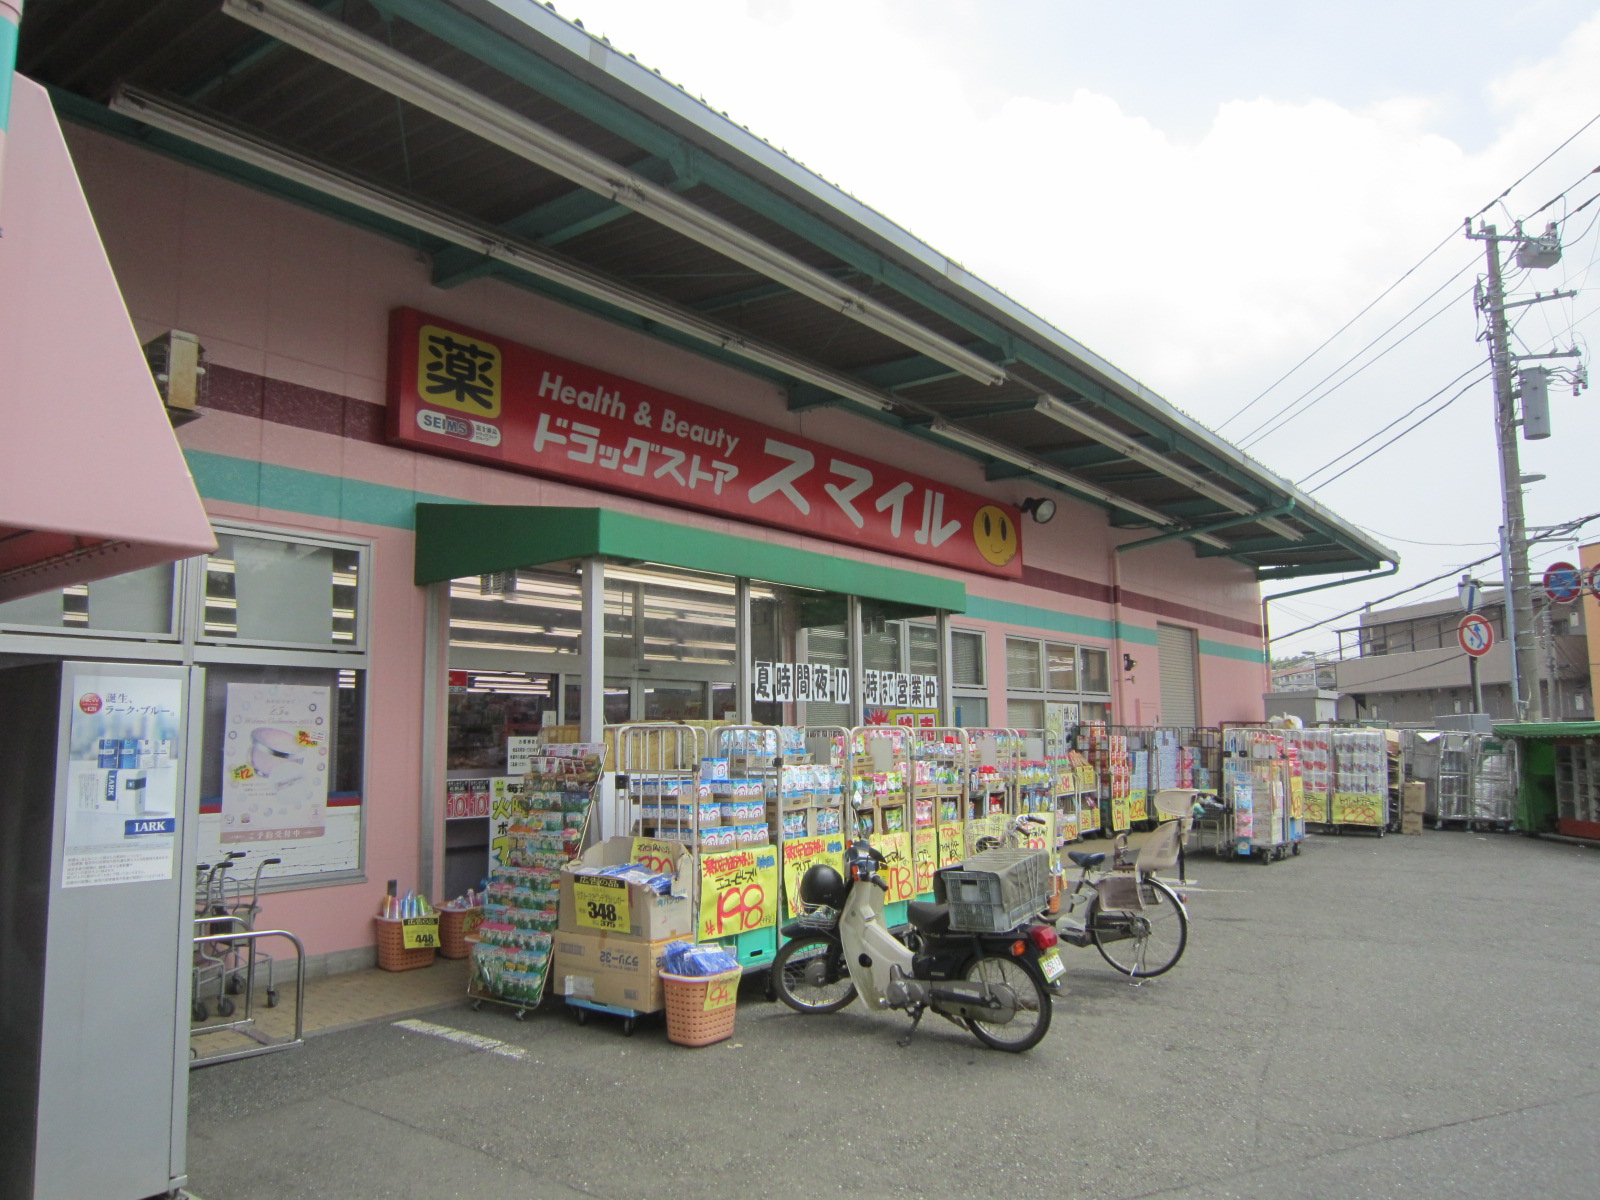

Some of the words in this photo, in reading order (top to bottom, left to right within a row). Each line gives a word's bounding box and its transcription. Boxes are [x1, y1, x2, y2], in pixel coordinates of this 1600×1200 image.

[425, 334, 495, 410] 薬
[423, 414, 468, 435] SEIMS
[538, 371, 626, 421] Health
[633, 401, 653, 428] &
[660, 409, 740, 457] Beauty
[533, 412, 739, 495] ドラッグストア
[748, 438, 962, 548] スマイル
[107, 774, 115, 797] LARK
[134, 820, 166, 833] LARK
[579, 875, 620, 888] 広告の品
[587, 901, 617, 922] 348
[415, 934, 434, 944] 448
